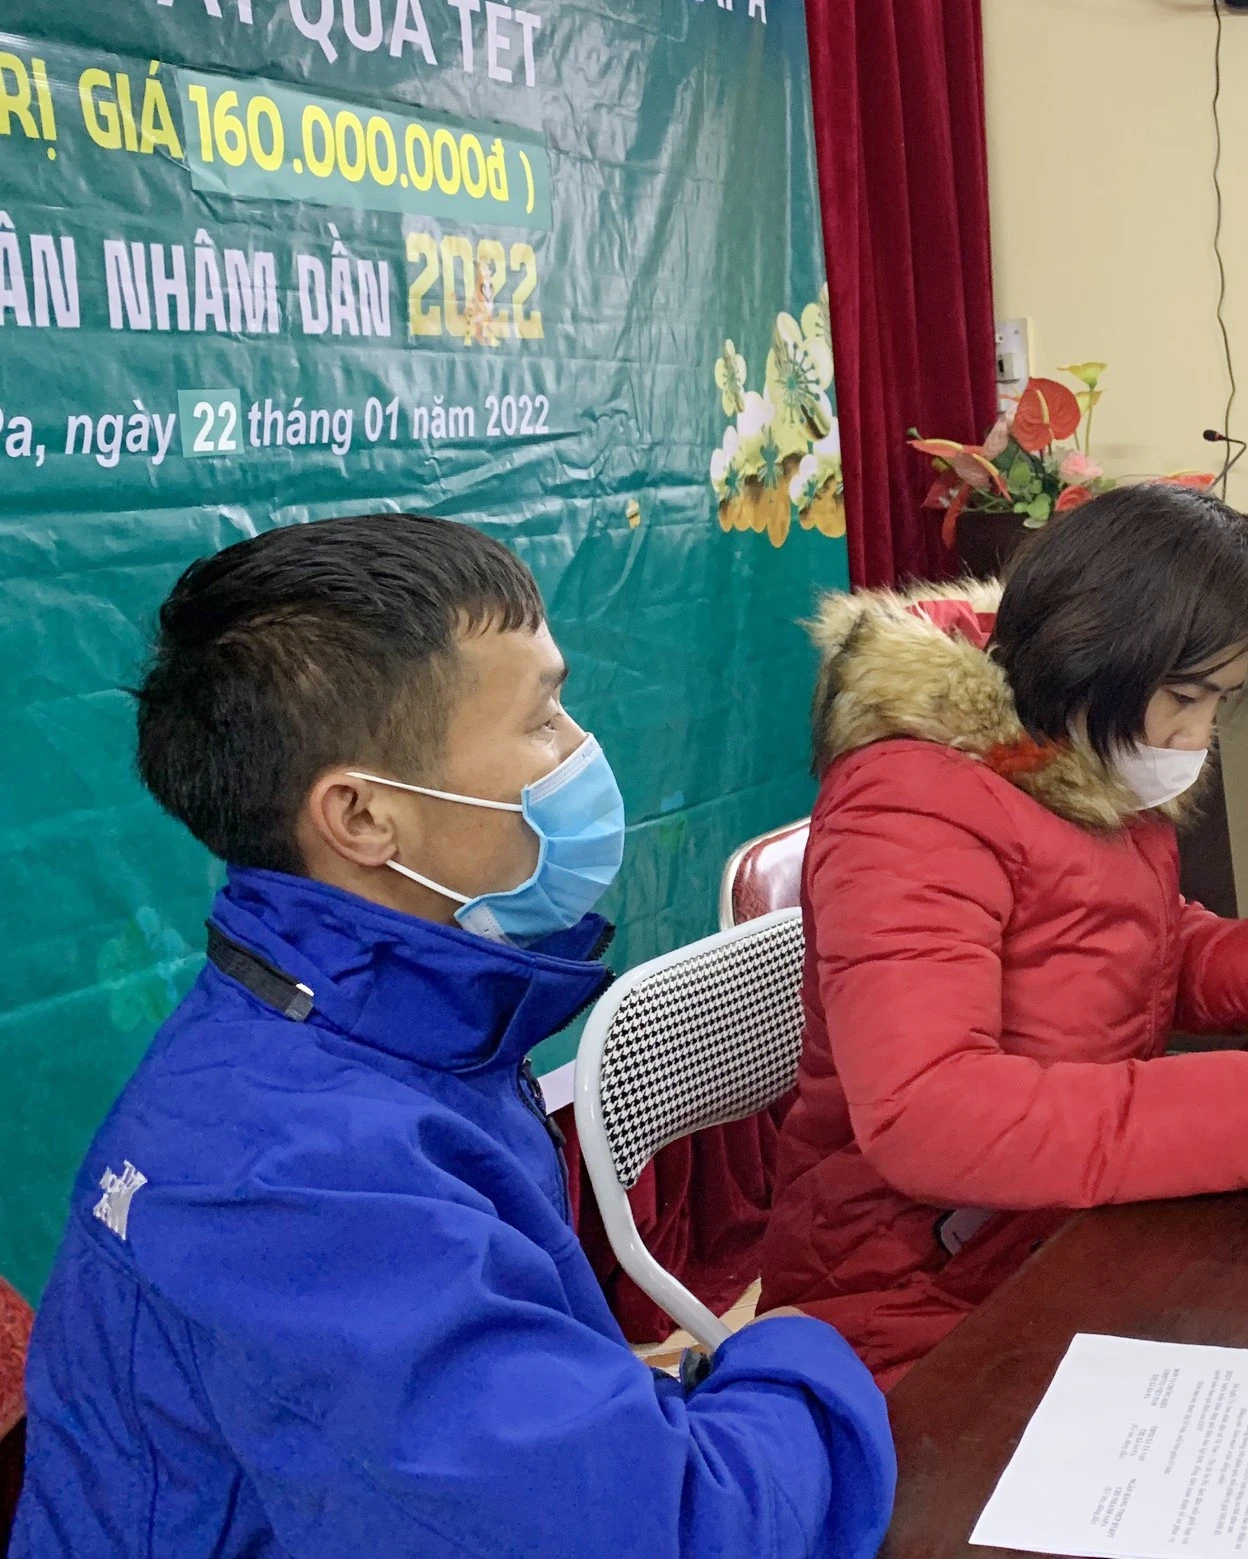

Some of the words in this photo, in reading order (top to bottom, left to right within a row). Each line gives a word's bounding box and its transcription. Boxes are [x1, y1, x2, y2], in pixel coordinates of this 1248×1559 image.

[78, 60, 183, 160] GIÁ
[103, 227, 280, 334] NHÂM
[298, 223, 392, 337] DẦN
[407, 232, 545, 347] 2022
[0, 407, 46, 468] a,
[64, 400, 176, 468] ngày
[193, 401, 238, 452] 22
[247, 397, 354, 455] tháng
[364, 397, 400, 442] 01
[412, 395, 476, 440] năm
[484, 394, 550, 440] 2022
